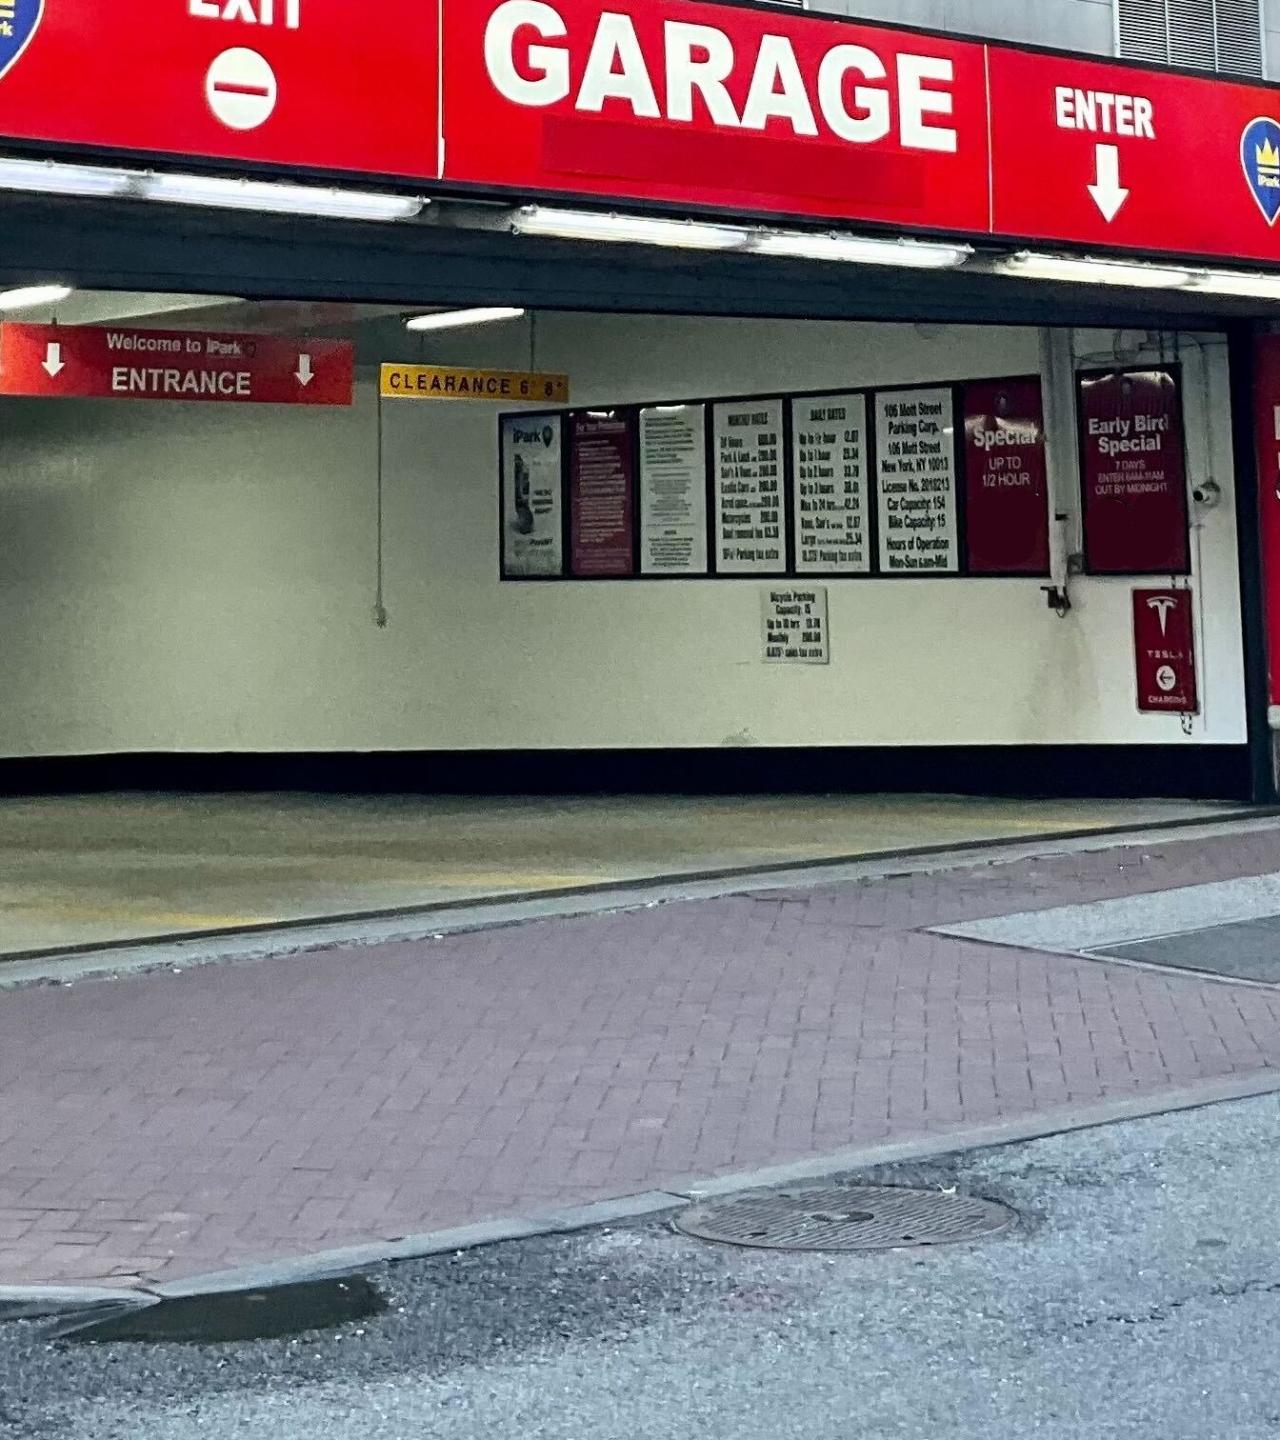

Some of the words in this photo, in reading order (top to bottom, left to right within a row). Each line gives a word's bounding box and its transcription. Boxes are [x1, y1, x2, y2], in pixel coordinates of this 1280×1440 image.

[1054, 86, 1156, 141] ENTER
[106, 331, 182, 352] Welcome
[186, 336, 202, 353] to
[206, 337, 242, 356] iPark
[112, 366, 252, 396] ENTRANCE
[389, 371, 511, 394] CLEARANCE
[1088, 417, 1130, 437] Early
[1098, 434, 1161, 457] Special
[989, 458, 1005, 470] UP
[1008, 456, 1022, 469] TO
[998, 472, 1031, 486] HOUR
[1147, 649, 1183, 659] TESLA
